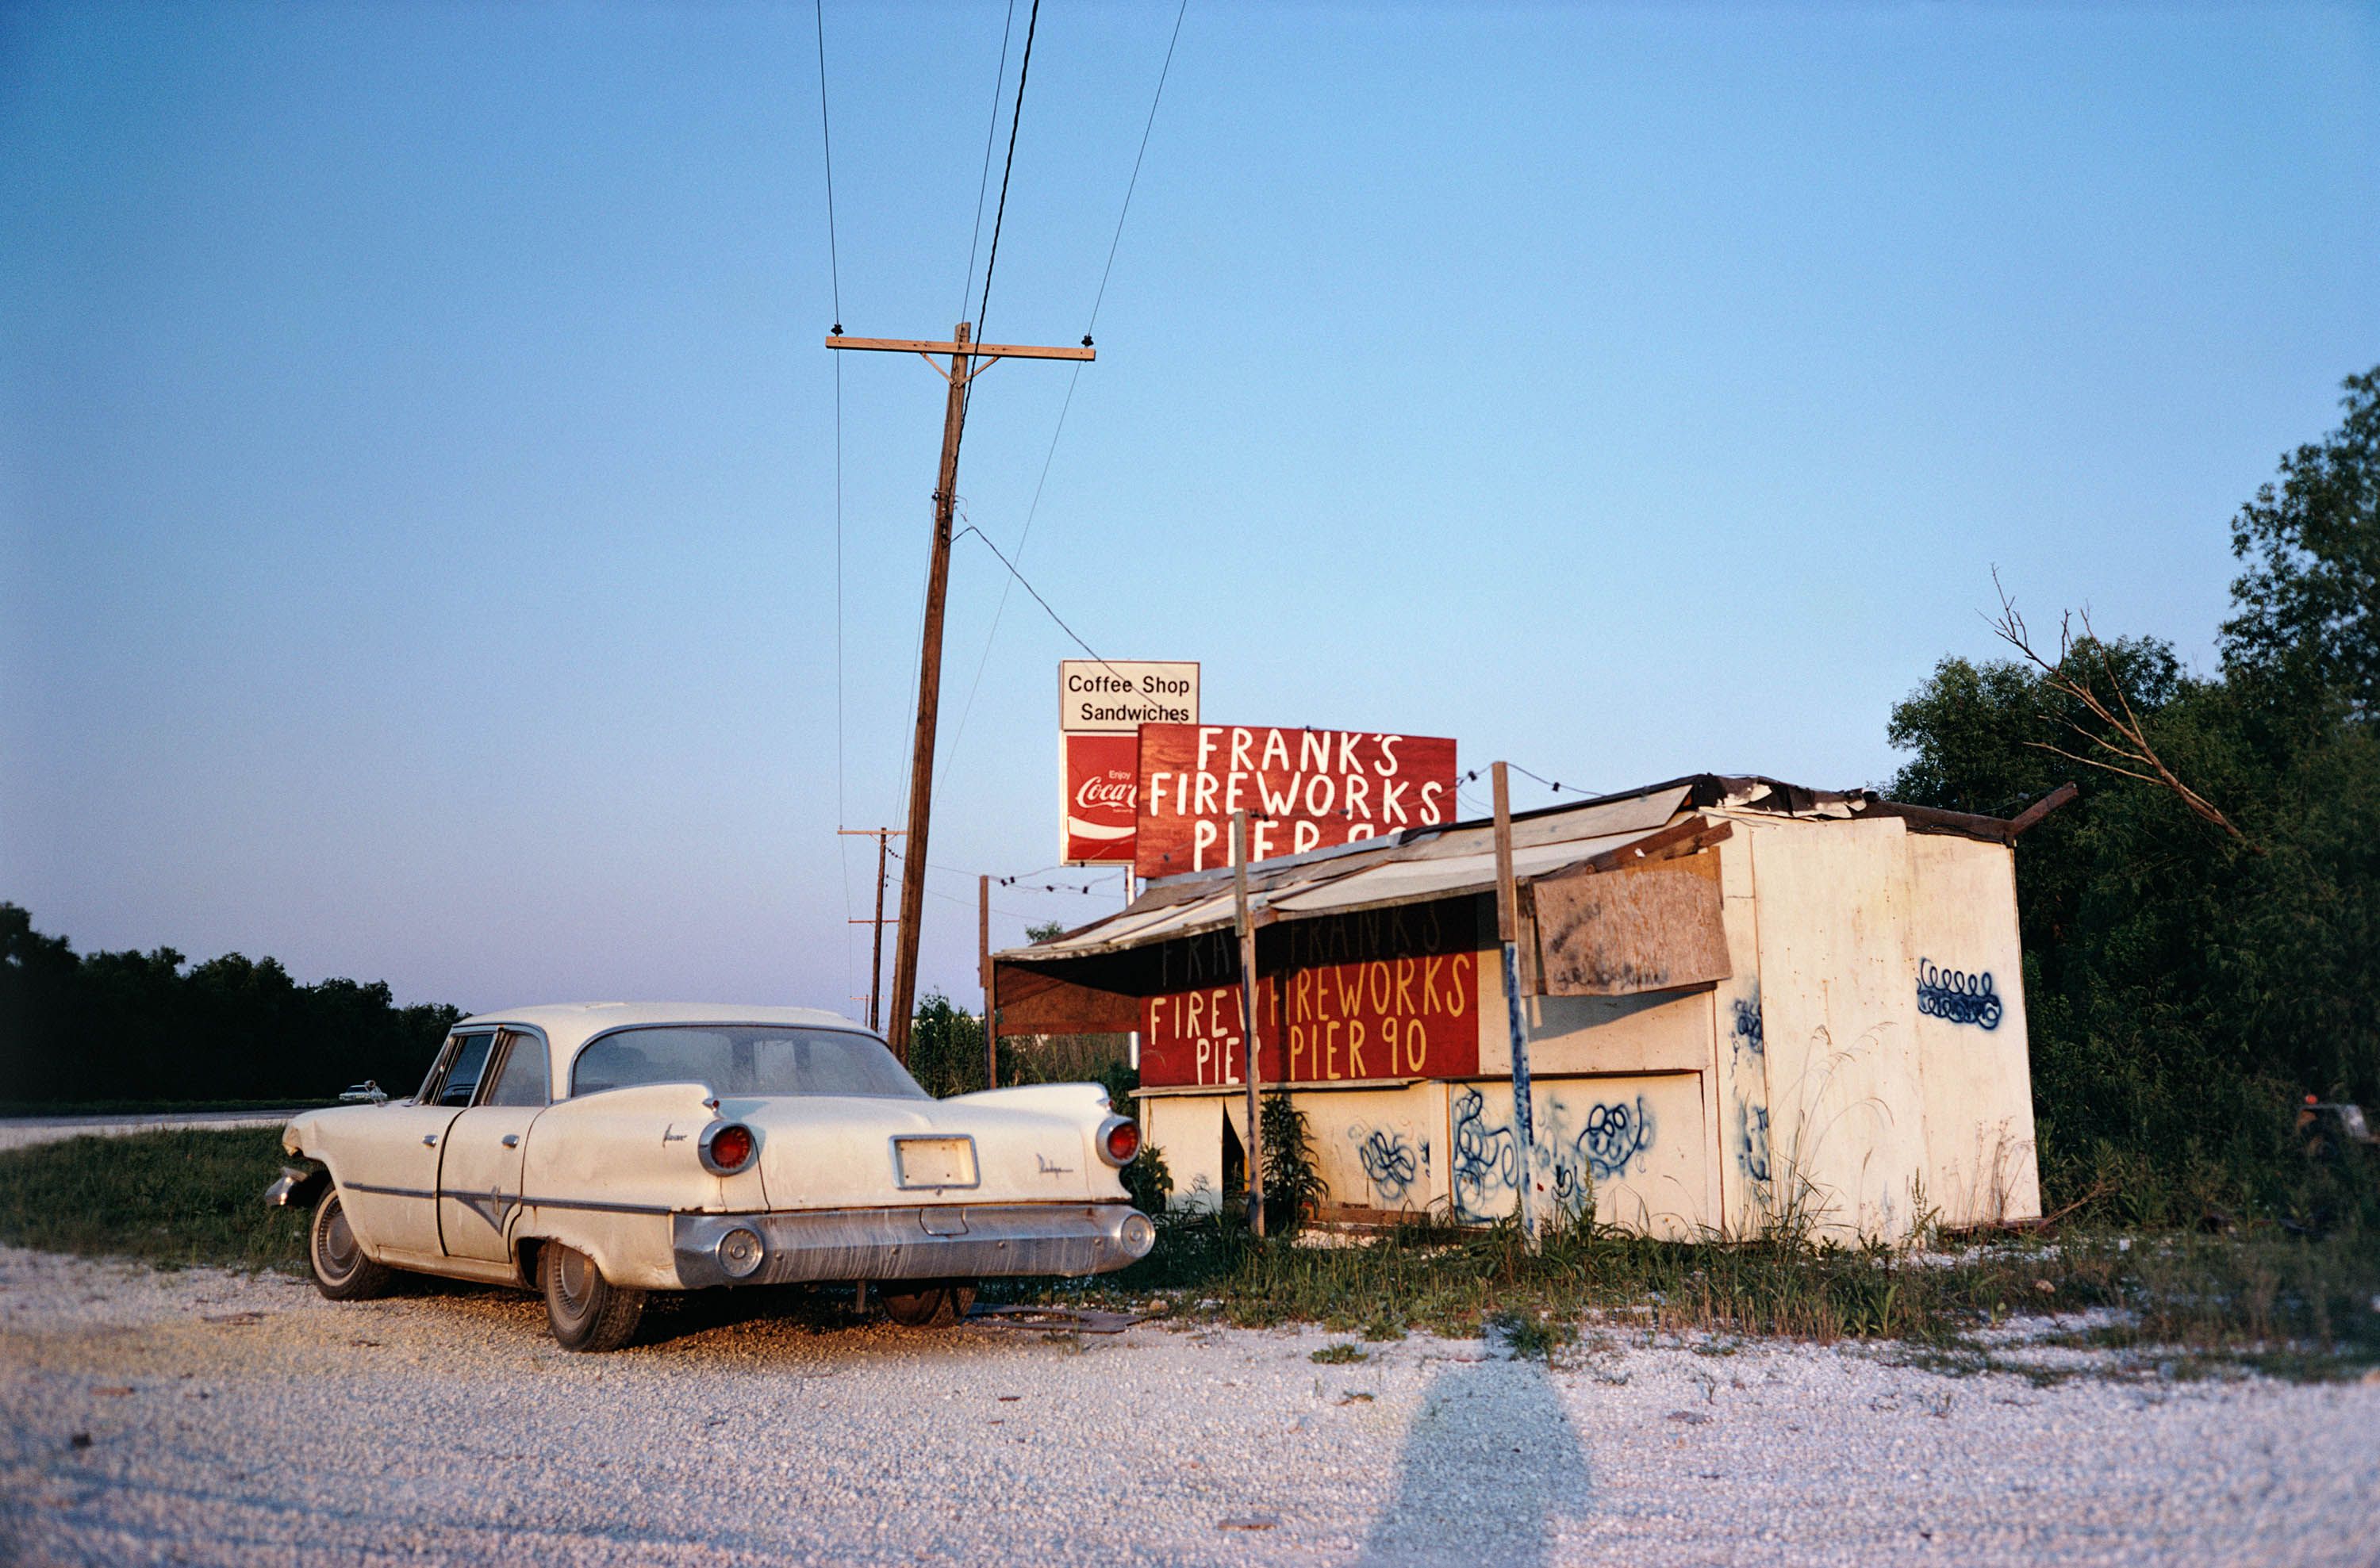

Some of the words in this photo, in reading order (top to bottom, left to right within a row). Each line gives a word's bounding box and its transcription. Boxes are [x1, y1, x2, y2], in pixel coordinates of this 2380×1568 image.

[1068, 675, 1133, 693] Coffee
[1142, 675, 1190, 696] Shop
[1081, 702, 1189, 722] Sandwiches
[1108, 769, 1132, 780] Enjoy
[1196, 726, 1403, 777] FRANK'S
[1150, 771, 1443, 826] FIREWORKS
[1192, 819, 1321, 872] PIER
[1270, 953, 1471, 1027] FIREWORKS
[1290, 1019, 1367, 1082] PIER
[1382, 1017, 1427, 1075] 90
